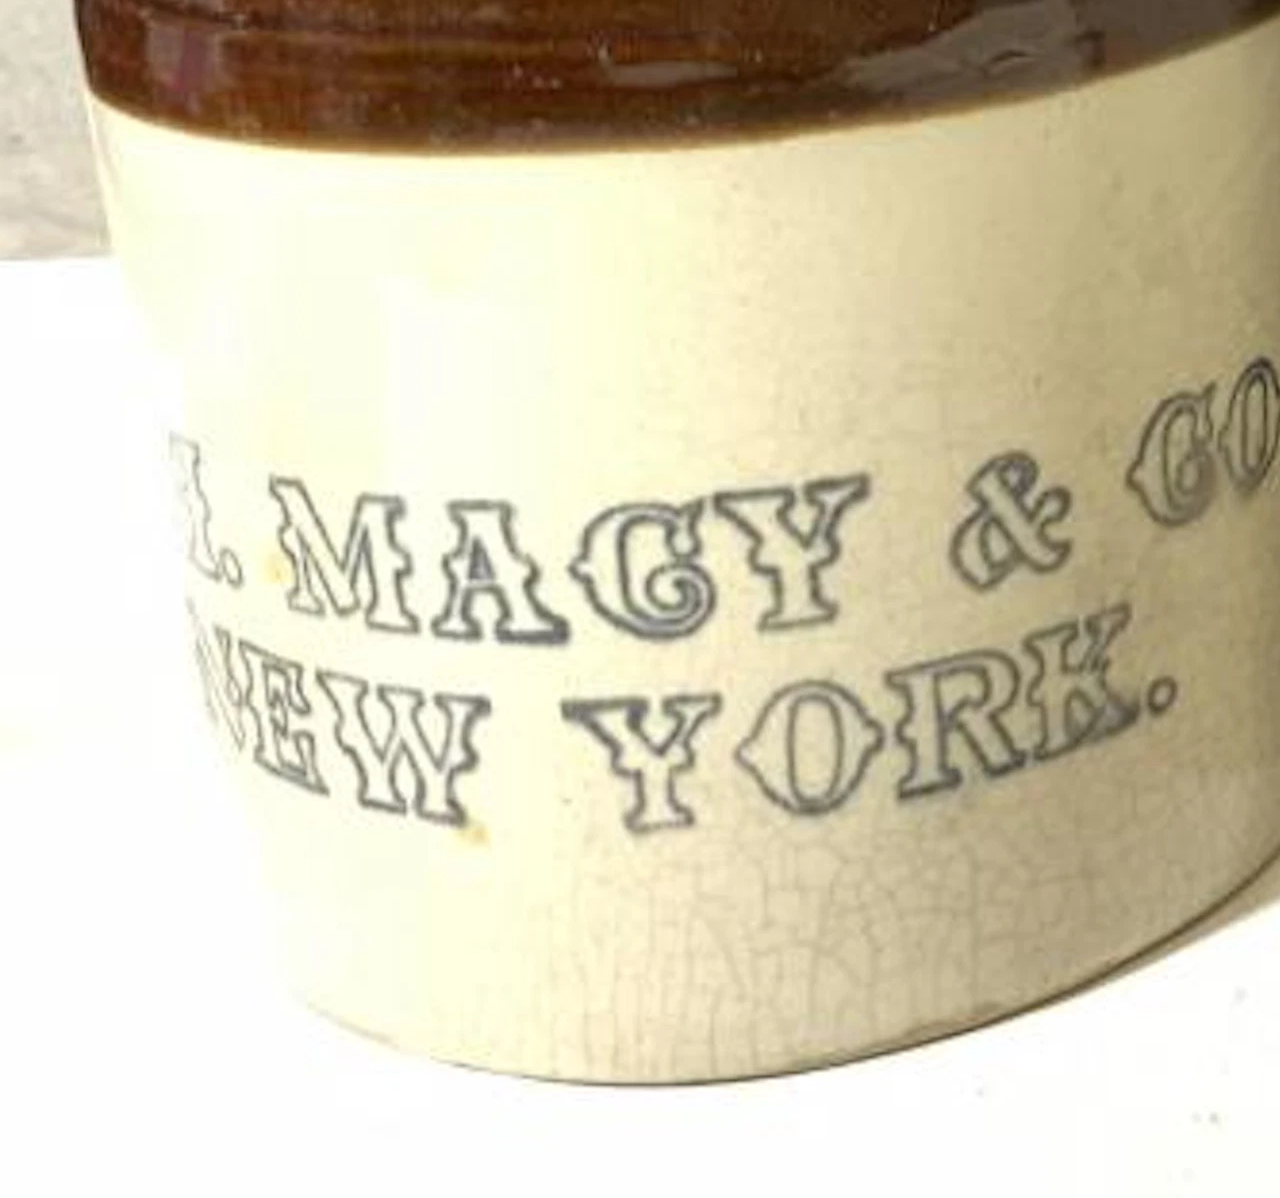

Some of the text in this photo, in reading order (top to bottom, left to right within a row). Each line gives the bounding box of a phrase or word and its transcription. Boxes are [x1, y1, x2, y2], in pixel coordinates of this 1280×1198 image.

[268, 473, 870, 644] MACY
[948, 450, 1073, 589] &
[186, 600, 1179, 834] NEW YORK.
